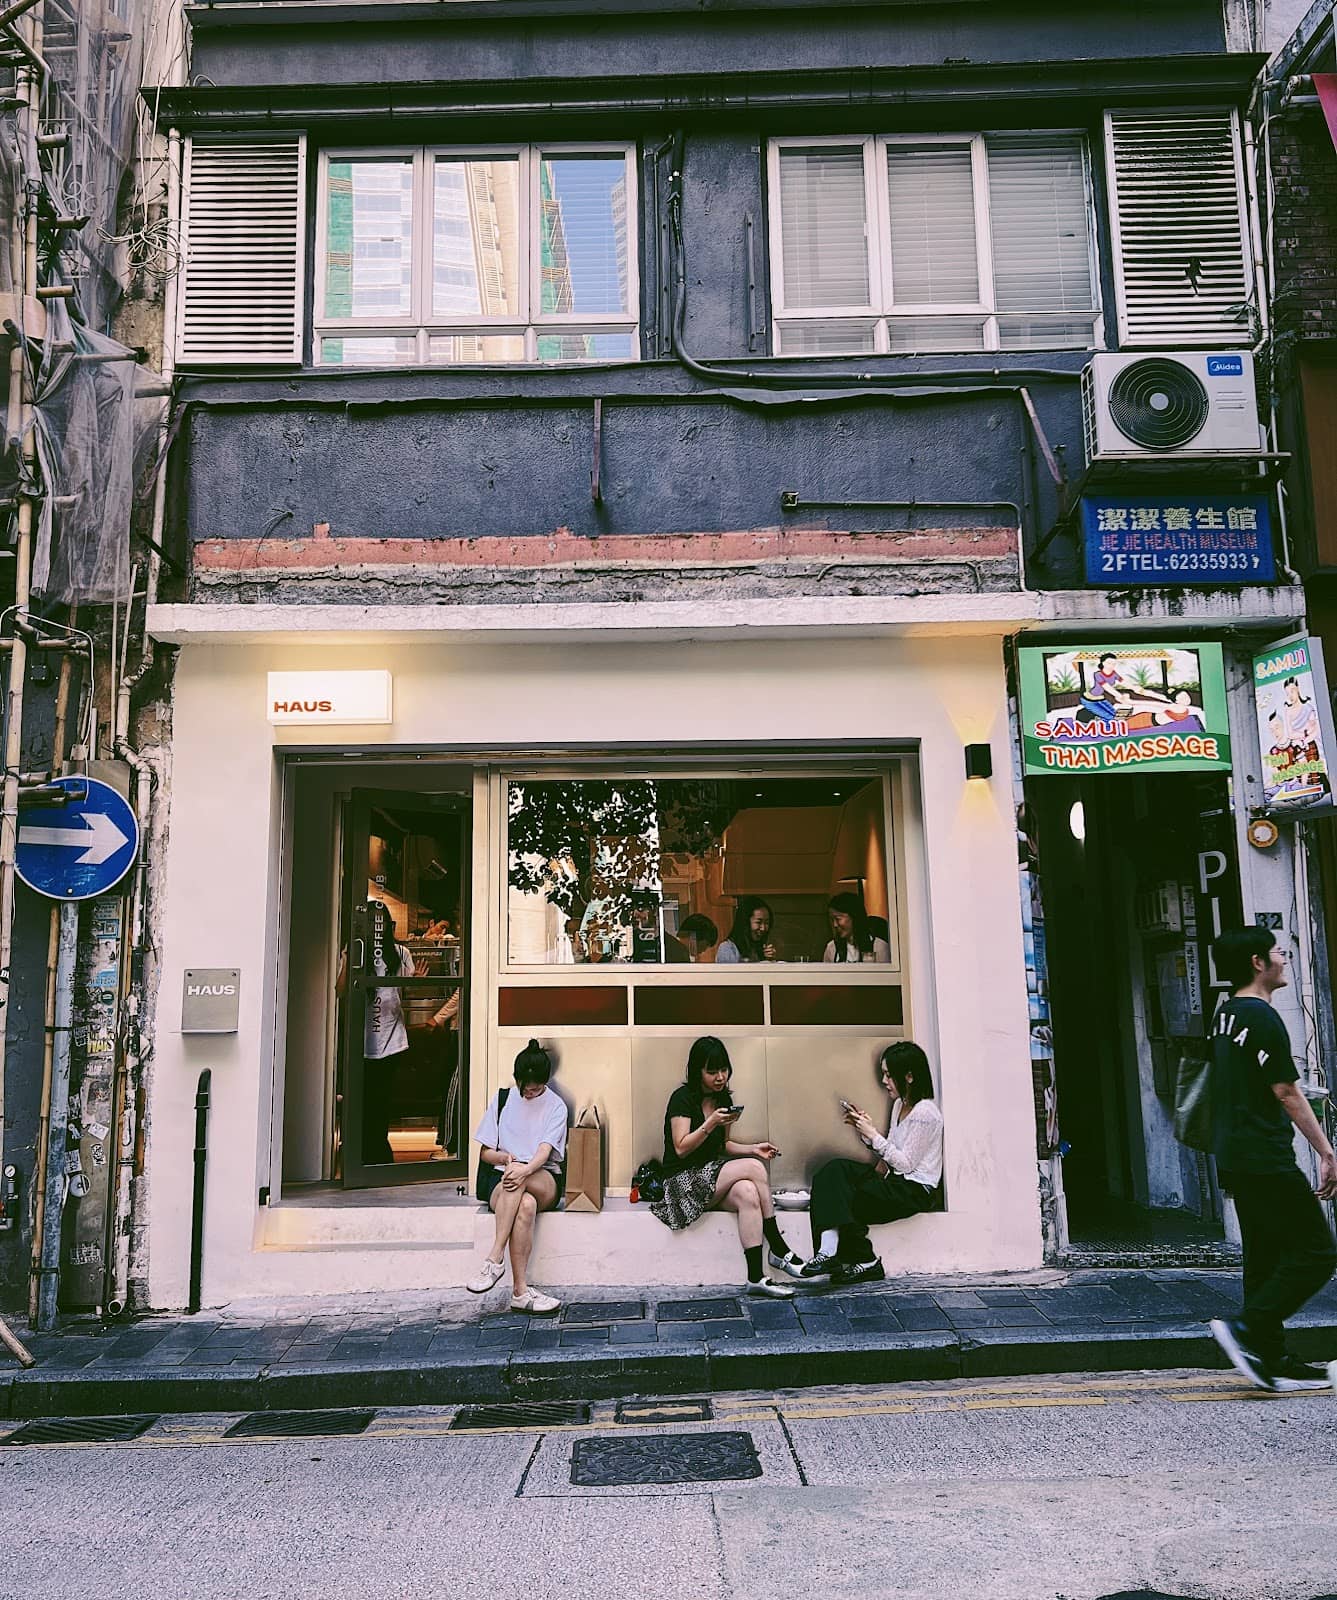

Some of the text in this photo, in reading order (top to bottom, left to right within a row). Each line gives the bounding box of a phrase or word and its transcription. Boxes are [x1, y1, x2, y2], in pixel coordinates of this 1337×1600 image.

[1211, 361, 1241, 371] Midea
[1097, 507, 1257, 531] 潔潔養生館
[1099, 533, 1258, 551] JIE JIE HEALTH MUSEUM
[1102, 554, 1127, 571] 2F
[1256, 648, 1306, 679] SAMUI
[1035, 720, 1128, 737] SAMUI
[1041, 736, 1219, 767] THAI MASSAGE
[1272, 761, 1324, 783] MASSAGE
[1258, 913, 1282, 929] 32
[372, 874, 385, 1033] HAUS COFFEE CLUB
[187, 985, 236, 996] HAUS
